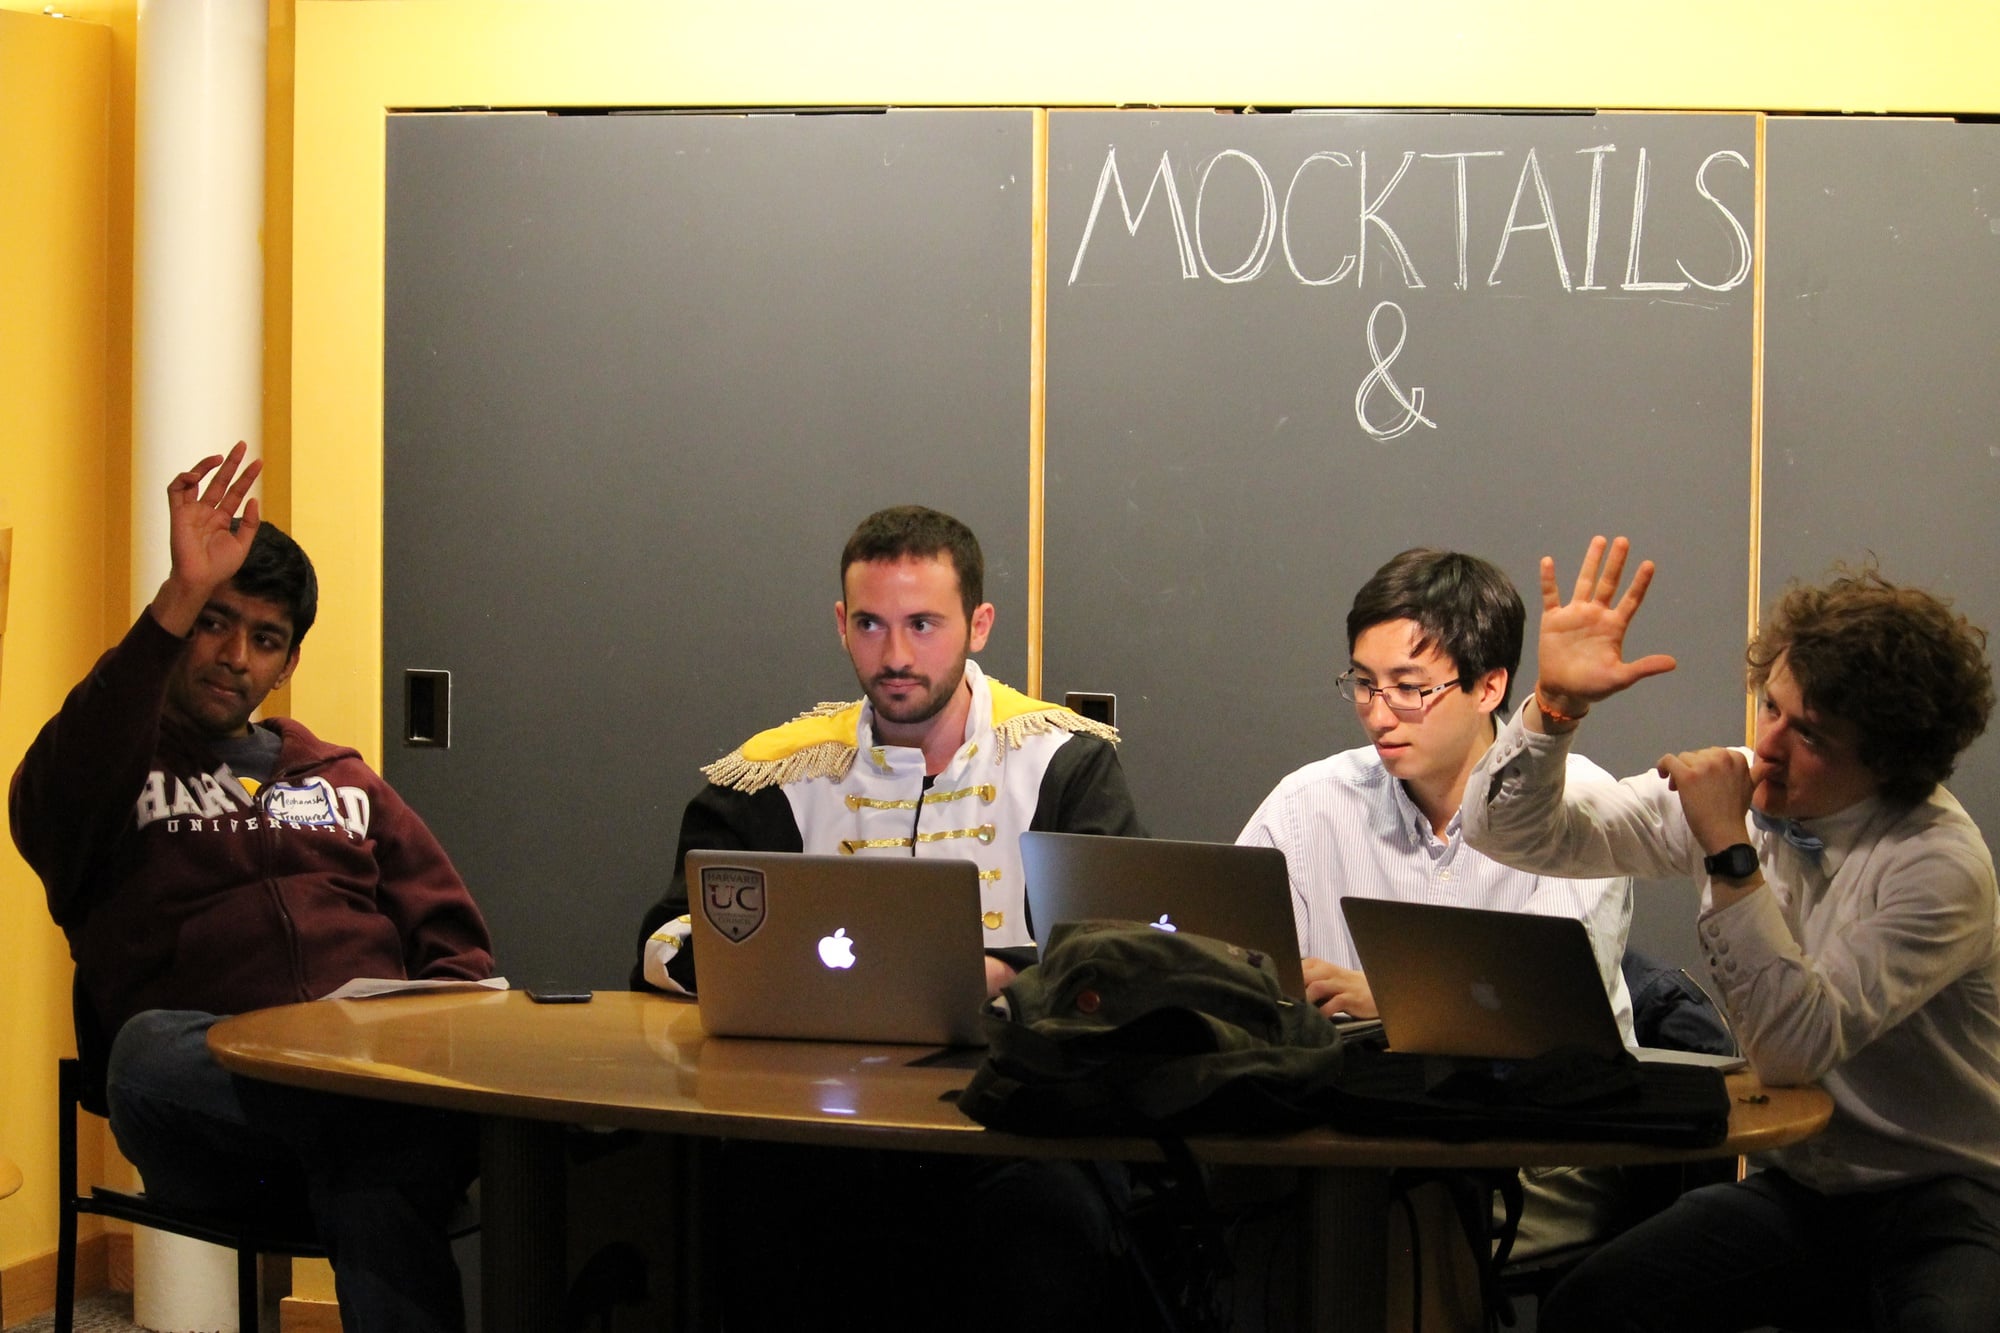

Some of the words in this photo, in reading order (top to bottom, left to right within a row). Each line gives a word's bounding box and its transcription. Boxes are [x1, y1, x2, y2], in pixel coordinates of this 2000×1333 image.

[1068, 144, 1752, 293] MOCKTAILS
[1355, 301, 1437, 441] &
[708, 884, 759, 912] UC
